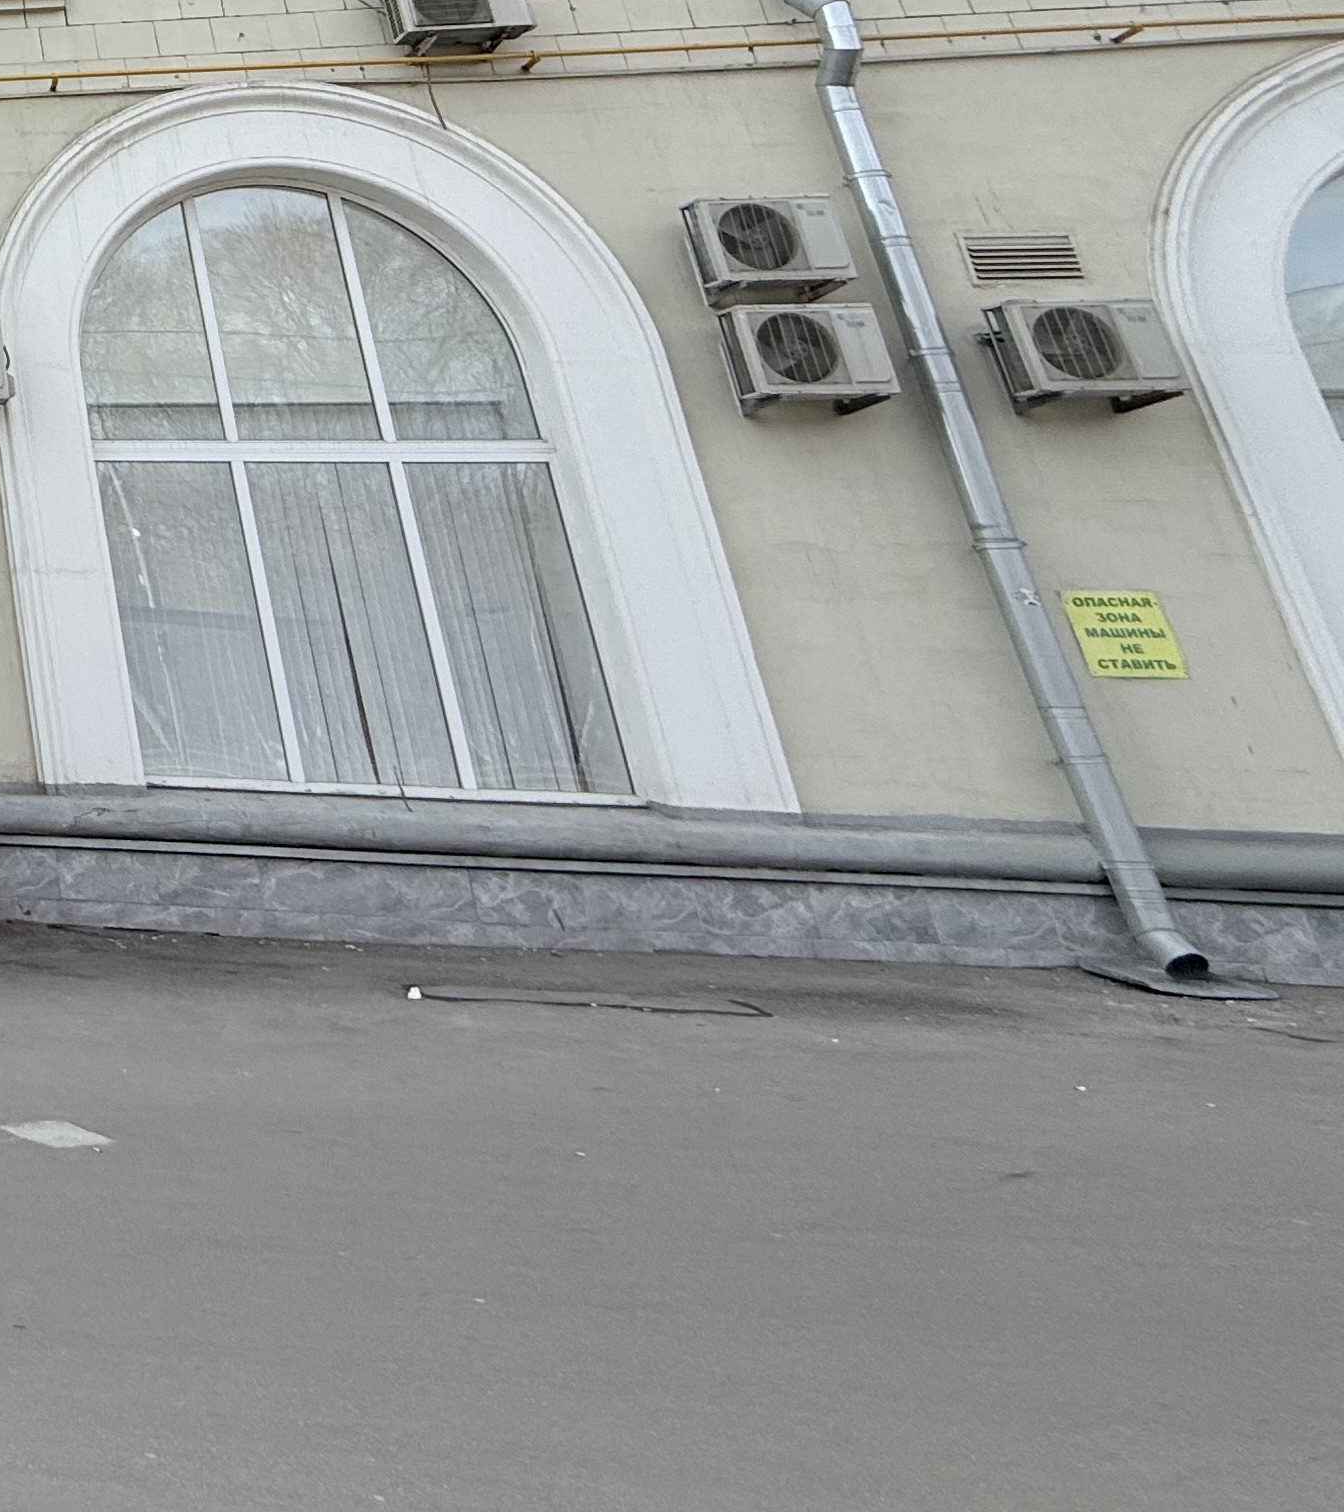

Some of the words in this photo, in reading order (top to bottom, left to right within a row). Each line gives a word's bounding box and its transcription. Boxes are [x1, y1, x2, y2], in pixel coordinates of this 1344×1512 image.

[1072, 597, 1152, 608] ОПАСНАЯ
[1096, 612, 1142, 623] ЗОНА
[1084, 628, 1166, 639] МАШИНЫ
[1120, 643, 1144, 654] НЕ
[1098, 659, 1176, 670] СТАВИТЬ
